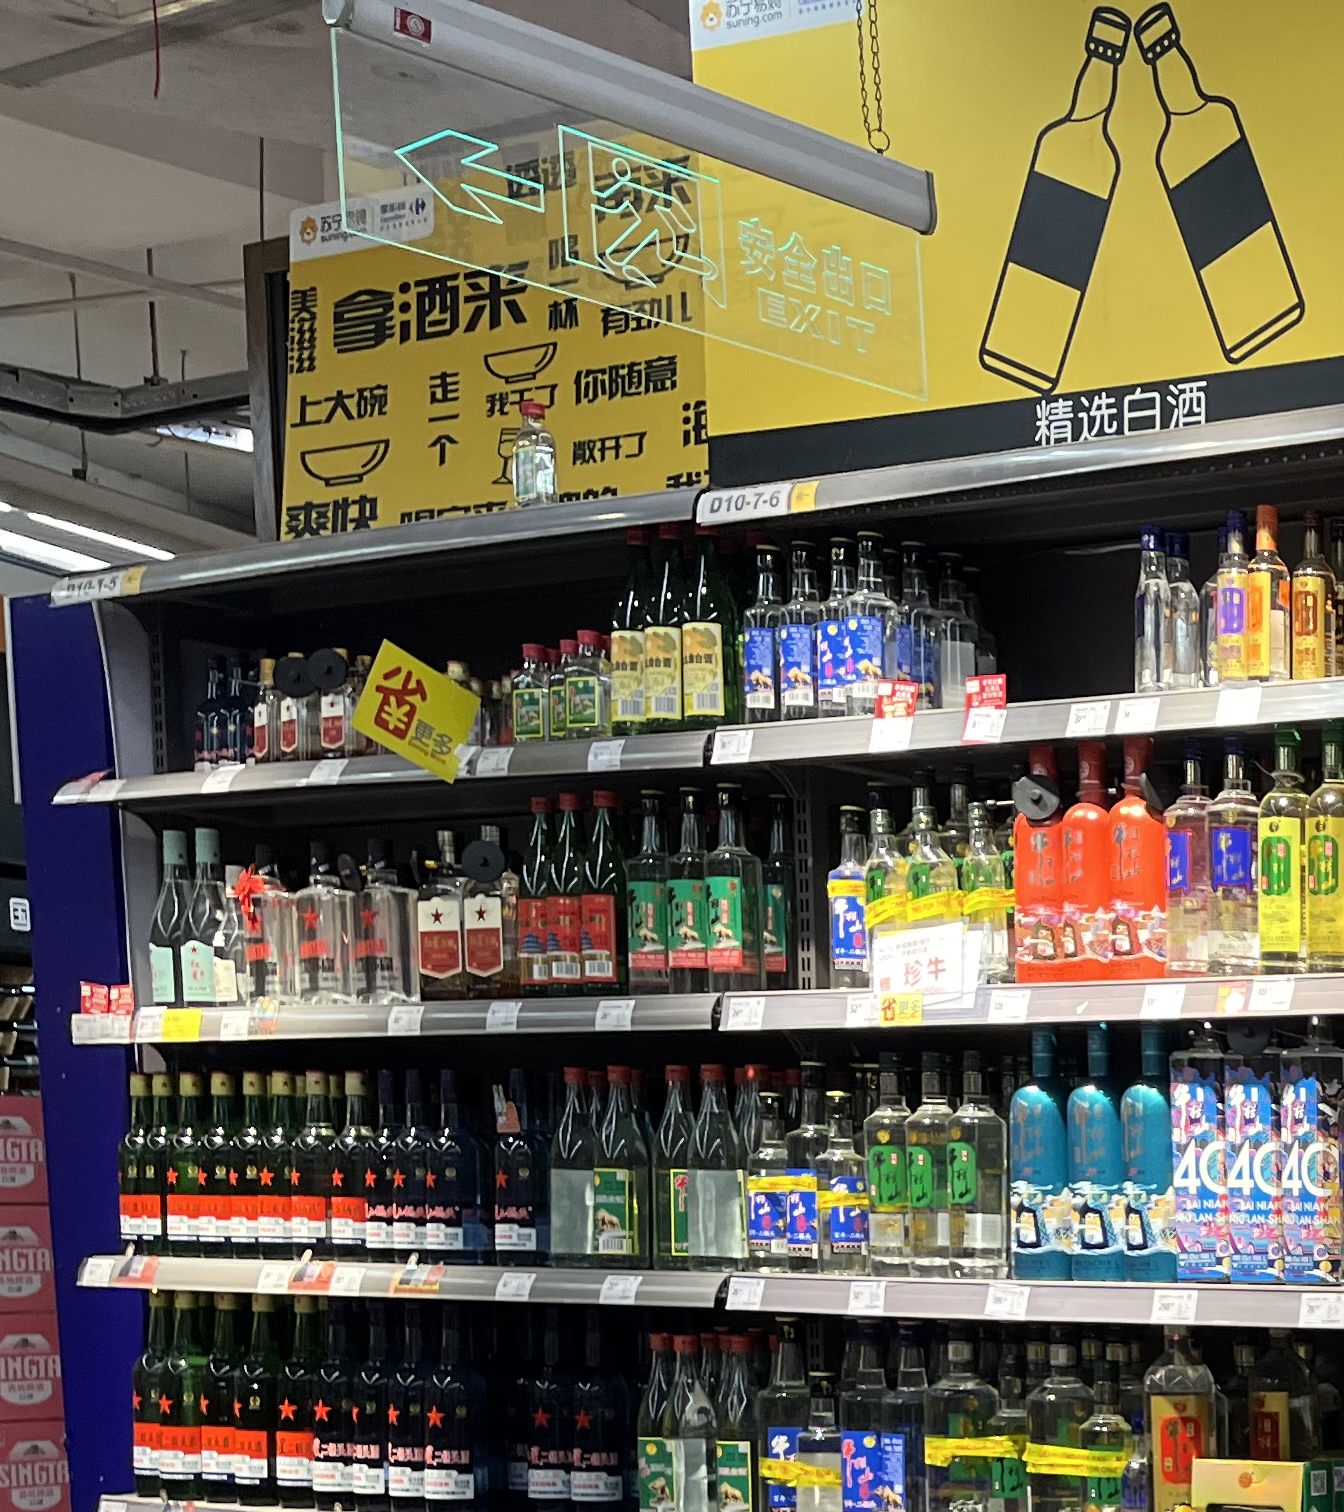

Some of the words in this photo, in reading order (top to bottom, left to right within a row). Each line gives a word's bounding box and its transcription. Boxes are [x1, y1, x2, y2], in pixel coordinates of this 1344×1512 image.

[725, 11, 784, 31] suning.com
[737, 216, 894, 316] 安全出口
[333, 259, 530, 354] 拿酒来
[756, 286, 876, 354] EXIT
[574, 355, 678, 406] 你随意
[290, 384, 389, 429] 上大碗
[428, 371, 460, 467] 走一个
[1034, 380, 1209, 447] 精选白酒
[572, 431, 648, 467] 敞开了
[285, 495, 379, 539] 爽快
[708, 489, 782, 515] D10-7-6
